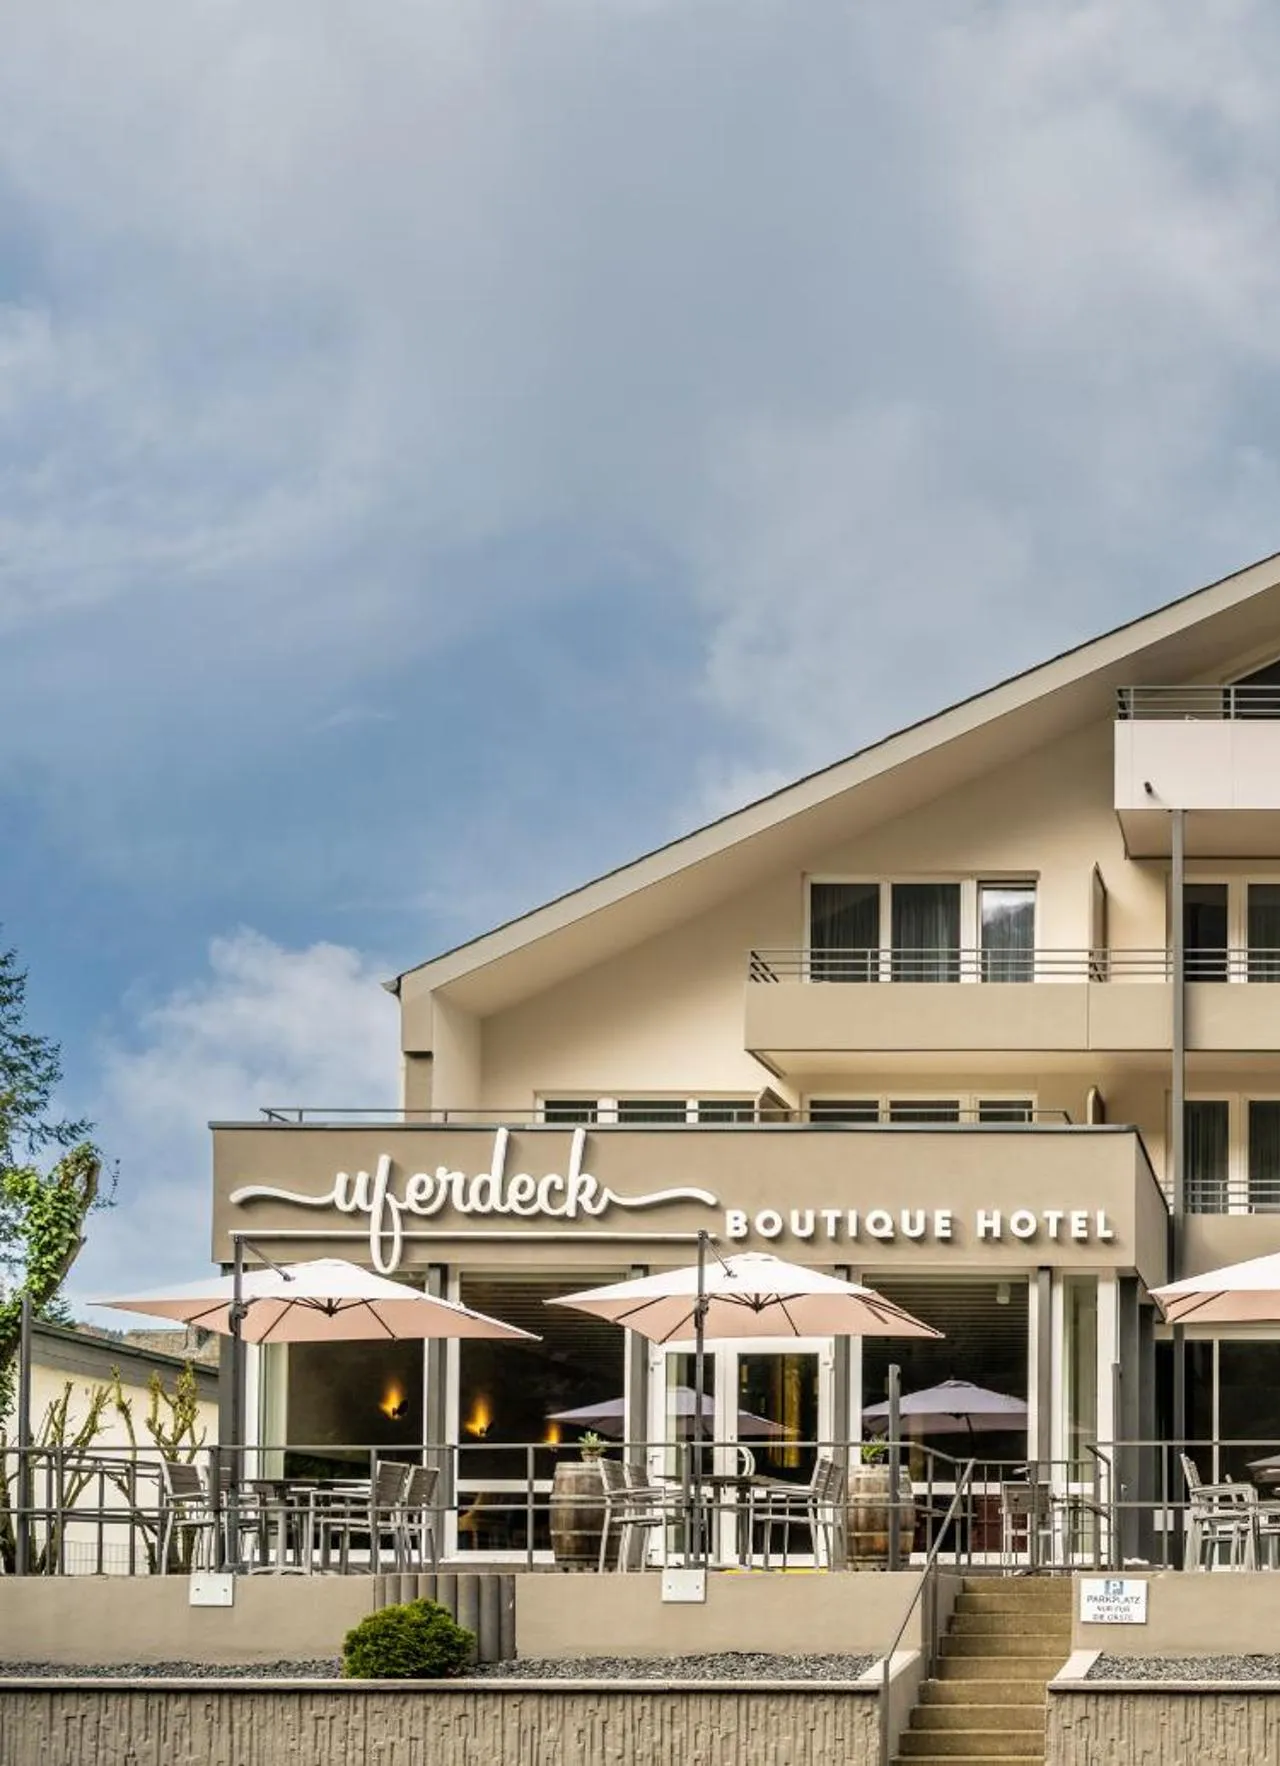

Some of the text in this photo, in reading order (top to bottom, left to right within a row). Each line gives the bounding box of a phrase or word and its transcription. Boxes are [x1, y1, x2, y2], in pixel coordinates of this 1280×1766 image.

[230, 1127, 717, 1275] uferdeck
[725, 1209, 1114, 1239] BOUTIQUE HOTEL
[1086, 1594, 1141, 1605] PARKPLATZ
